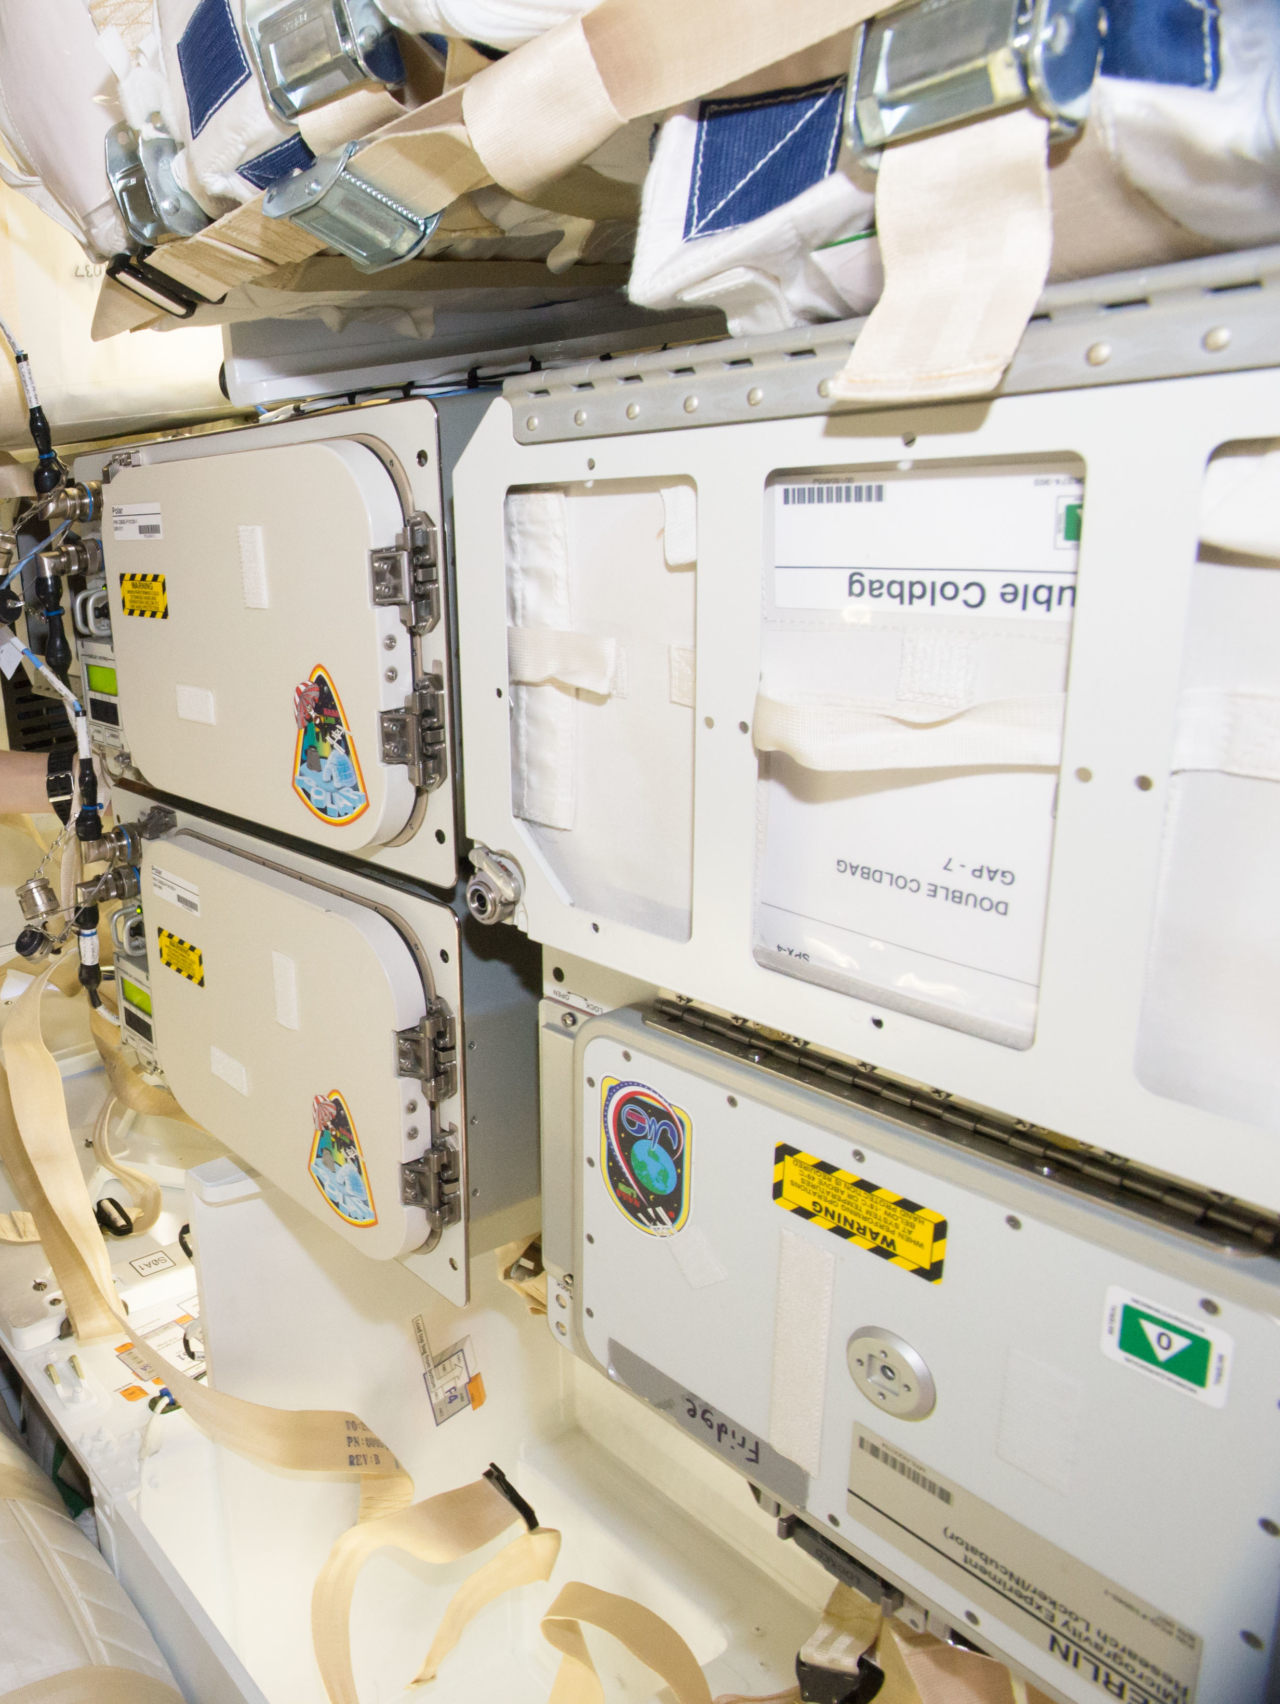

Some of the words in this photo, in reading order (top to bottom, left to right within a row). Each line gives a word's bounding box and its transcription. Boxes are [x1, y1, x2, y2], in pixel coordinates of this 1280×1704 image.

[847, 572, 987, 609] Coldbag
[1000, 582, 1076, 612] uble
[835, 858, 920, 893] COLDBAG
[942, 856, 953, 871] 7
[971, 864, 1015, 886] GAP
[926, 881, 1008, 916] DOUBLE
[552, 989, 569, 1000] OPEN
[585, 1002, 603, 1013] LOCK
[792, 1159, 833, 1182] REQUIRED
[835, 1178, 842, 1186] IS
[789, 1179, 839, 1209] OPERATIONS
[800, 1177, 864, 1213] TEMPERATURES
[817, 1178, 845, 1197] ABOVE
[843, 1182, 898, 1213] PROTECTION
[846, 1192, 858, 1202] OR
[812, 1200, 897, 1251] WARNING
[840, 1204, 896, 1236] PERFORMING
[865, 1208, 900, 1230] SYSTEM
[883, 1210, 916, 1230] BELOW
[899, 1211, 925, 1226] HAND
[902, 1226, 914, 1236] AT
[898, 1232, 925, 1250] WHEN
[444, 1385, 459, 1405] F4
[684, 1397, 758, 1464] Fridge
[943, 1526, 1090, 1632] Locker/INcubator)
[963, 1554, 1055, 1623] Experiment
[1049, 1634, 1149, 1704] ERLIN
[1060, 1619, 1180, 1704] Microgravity
